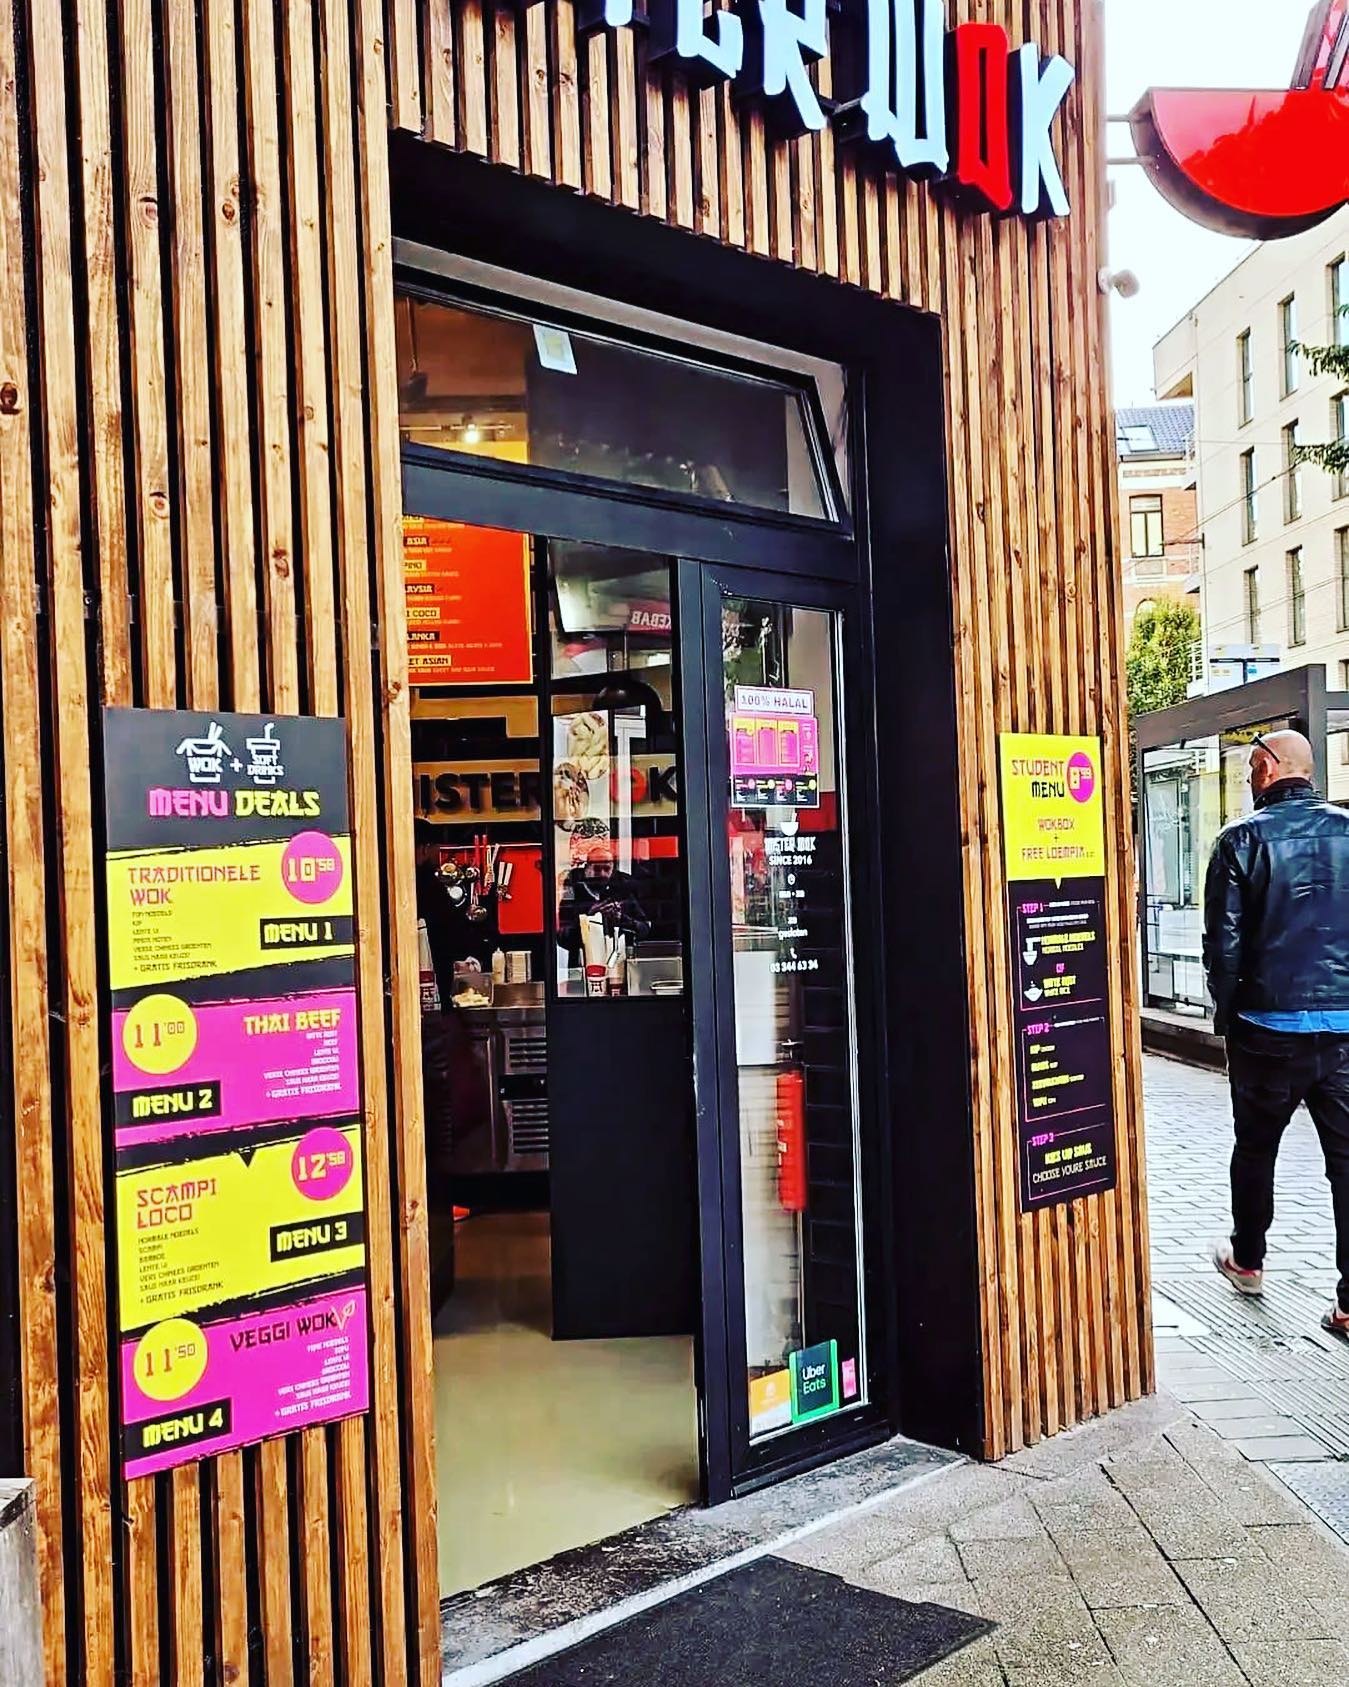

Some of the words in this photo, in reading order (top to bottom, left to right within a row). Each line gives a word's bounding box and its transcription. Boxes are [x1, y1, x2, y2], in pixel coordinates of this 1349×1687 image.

[861, 0, 1075, 216] WOK
[412, 609, 437, 617] COCO
[741, 695, 770, 706] 100%
[774, 696, 808, 709] HALAL
[188, 756, 223, 773] WOK
[252, 754, 277, 765] SOFT
[1011, 759, 1064, 778] STUDENT
[1031, 781, 1065, 798] MENU
[149, 789, 228, 816] MENU
[235, 789, 320, 817] DEALS
[769, 855, 792, 865] SINCE
[793, 854, 813, 866] 2016
[1021, 847, 1044, 861] FREE
[128, 865, 261, 884] TRADITIONELE
[129, 888, 172, 906] WOK
[264, 923, 318, 944] MENU
[324, 921, 333, 941] 1
[243, 1012, 291, 1036] THAI
[296, 1008, 341, 1031] BEEF
[1027, 1023, 1043, 1035] STEP
[132, 1091, 194, 1118] MENU
[199, 1089, 213, 1110] 2
[1032, 1134, 1048, 1146] STEP
[1033, 1168, 1060, 1183] CHOOSE
[1085, 1155, 1107, 1170] SAUCE
[137, 1178, 216, 1208] SCAMPI
[137, 1204, 193, 1229] LOCO
[276, 1223, 331, 1253] MENU
[335, 1221, 348, 1240] 3
[146, 1290, 176, 1304] GRATIS
[179, 1280, 224, 1296] FRISDRANK
[229, 1320, 290, 1352] VEGGI
[297, 1312, 337, 1336] WOK
[802, 1363, 826, 1381] Uber
[803, 1378, 827, 1395] Eats
[142, 1413, 204, 1448] MENU
[208, 1407, 223, 1429] 4
